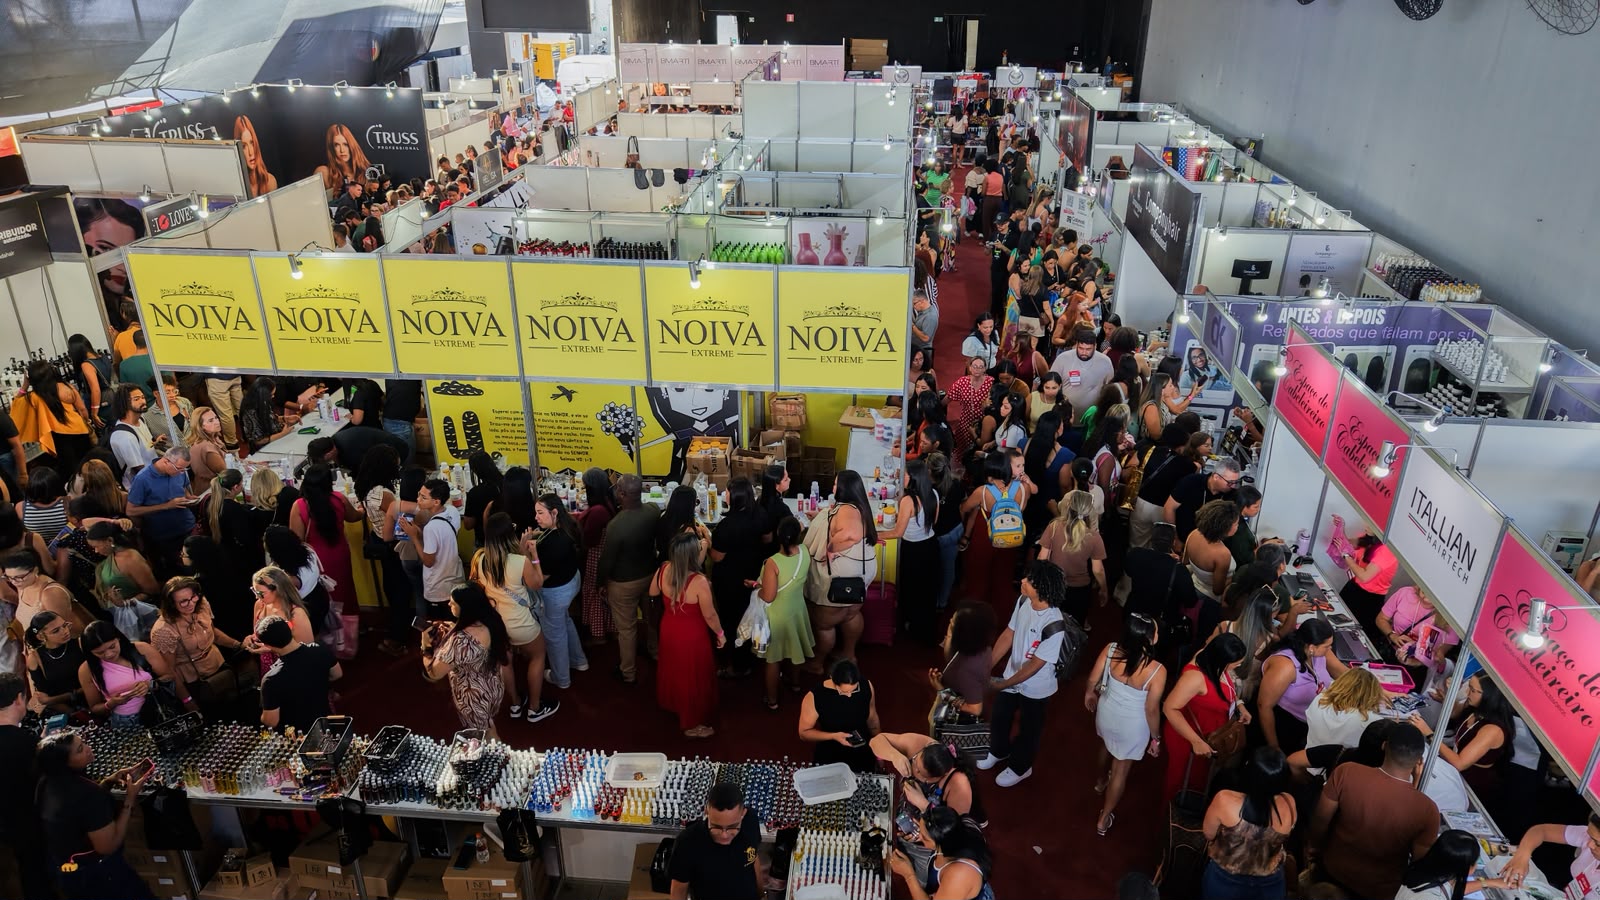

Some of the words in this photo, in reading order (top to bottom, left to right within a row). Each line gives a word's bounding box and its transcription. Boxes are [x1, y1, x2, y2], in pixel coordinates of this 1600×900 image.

[372, 131, 419, 145] TRUSS
[168, 206, 192, 227] LOVE
[148, 303, 257, 331] NOIVA
[273, 307, 381, 334] NOIVA
[398, 309, 507, 338] NOIVA
[526, 314, 636, 343] NOIVA
[1278, 308, 1321, 324] ANTES
[186, 332, 228, 341] EXTREME
[309, 336, 351, 345] EXTREME
[433, 339, 476, 348] EXTREME
[657, 319, 767, 347] NOIVA
[787, 325, 897, 353] NOIVA
[1262, 324, 1344, 339] Restados
[1349, 328, 1377, 342] que
[1382, 326, 1423, 340] falam
[1427, 329, 1454, 343] por
[561, 344, 604, 353] EXTREME
[691, 349, 734, 358] EXTREME
[820, 355, 864, 364] EXTREME
[1336, 423, 1391, 498] Cabeleiiro
[1411, 486, 1477, 572] ITALLIAN
[1427, 532, 1469, 584] HAIRTECH
[1516, 589, 1576, 672] Eaço
[1493, 593, 1593, 729] Caeleireiro
